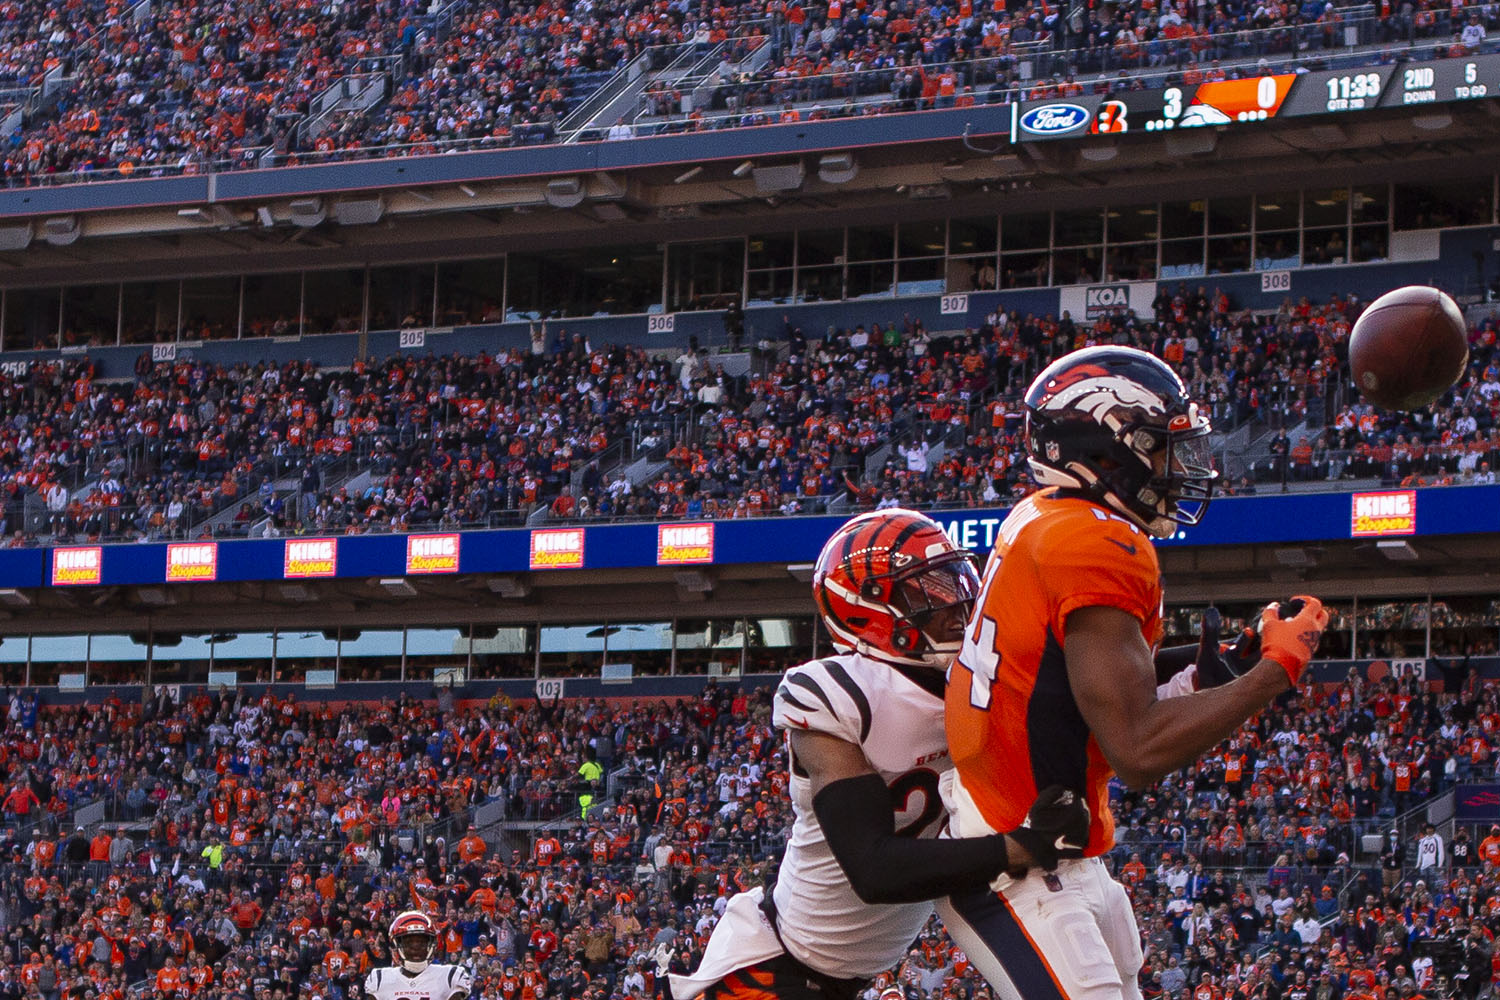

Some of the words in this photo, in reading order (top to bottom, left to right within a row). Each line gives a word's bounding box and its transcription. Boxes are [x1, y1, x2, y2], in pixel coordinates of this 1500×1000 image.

[1404, 68, 1434, 89] 2ND
[1465, 63, 1477, 83] 5
[1257, 76, 1277, 108] 0
[1327, 73, 1381, 99] 11:33
[1455, 86, 1470, 97] TO
[1471, 84, 1487, 97] GO
[1164, 88, 1182, 118] 3
[1327, 100, 1348, 111] QTR
[1403, 90, 1436, 104] DOWN
[1032, 107, 1076, 129] Ford
[1263, 274, 1289, 291] 308
[942, 296, 968, 313] 307
[1088, 287, 1128, 307] KOA
[650, 317, 673, 331] 306
[401, 331, 424, 345] 305
[154, 346, 175, 358] 304
[1356, 494, 1411, 517] KING
[1355, 515, 1412, 535] Soopers
[534, 531, 580, 551] KING
[662, 526, 709, 547] KING
[170, 546, 213, 564] KING
[289, 541, 332, 560] KING
[411, 537, 455, 556] KING
[661, 545, 709, 562] Soopers
[57, 550, 97, 568] KING
[410, 555, 455, 571] Soopers
[533, 550, 580, 567] Soopers
[56, 567, 97, 582] Soopers
[170, 564, 213, 580] Soopers
[287, 559, 333, 576] Soopers
[538, 682, 562, 698] 103
[593, 842, 606, 853] 55
